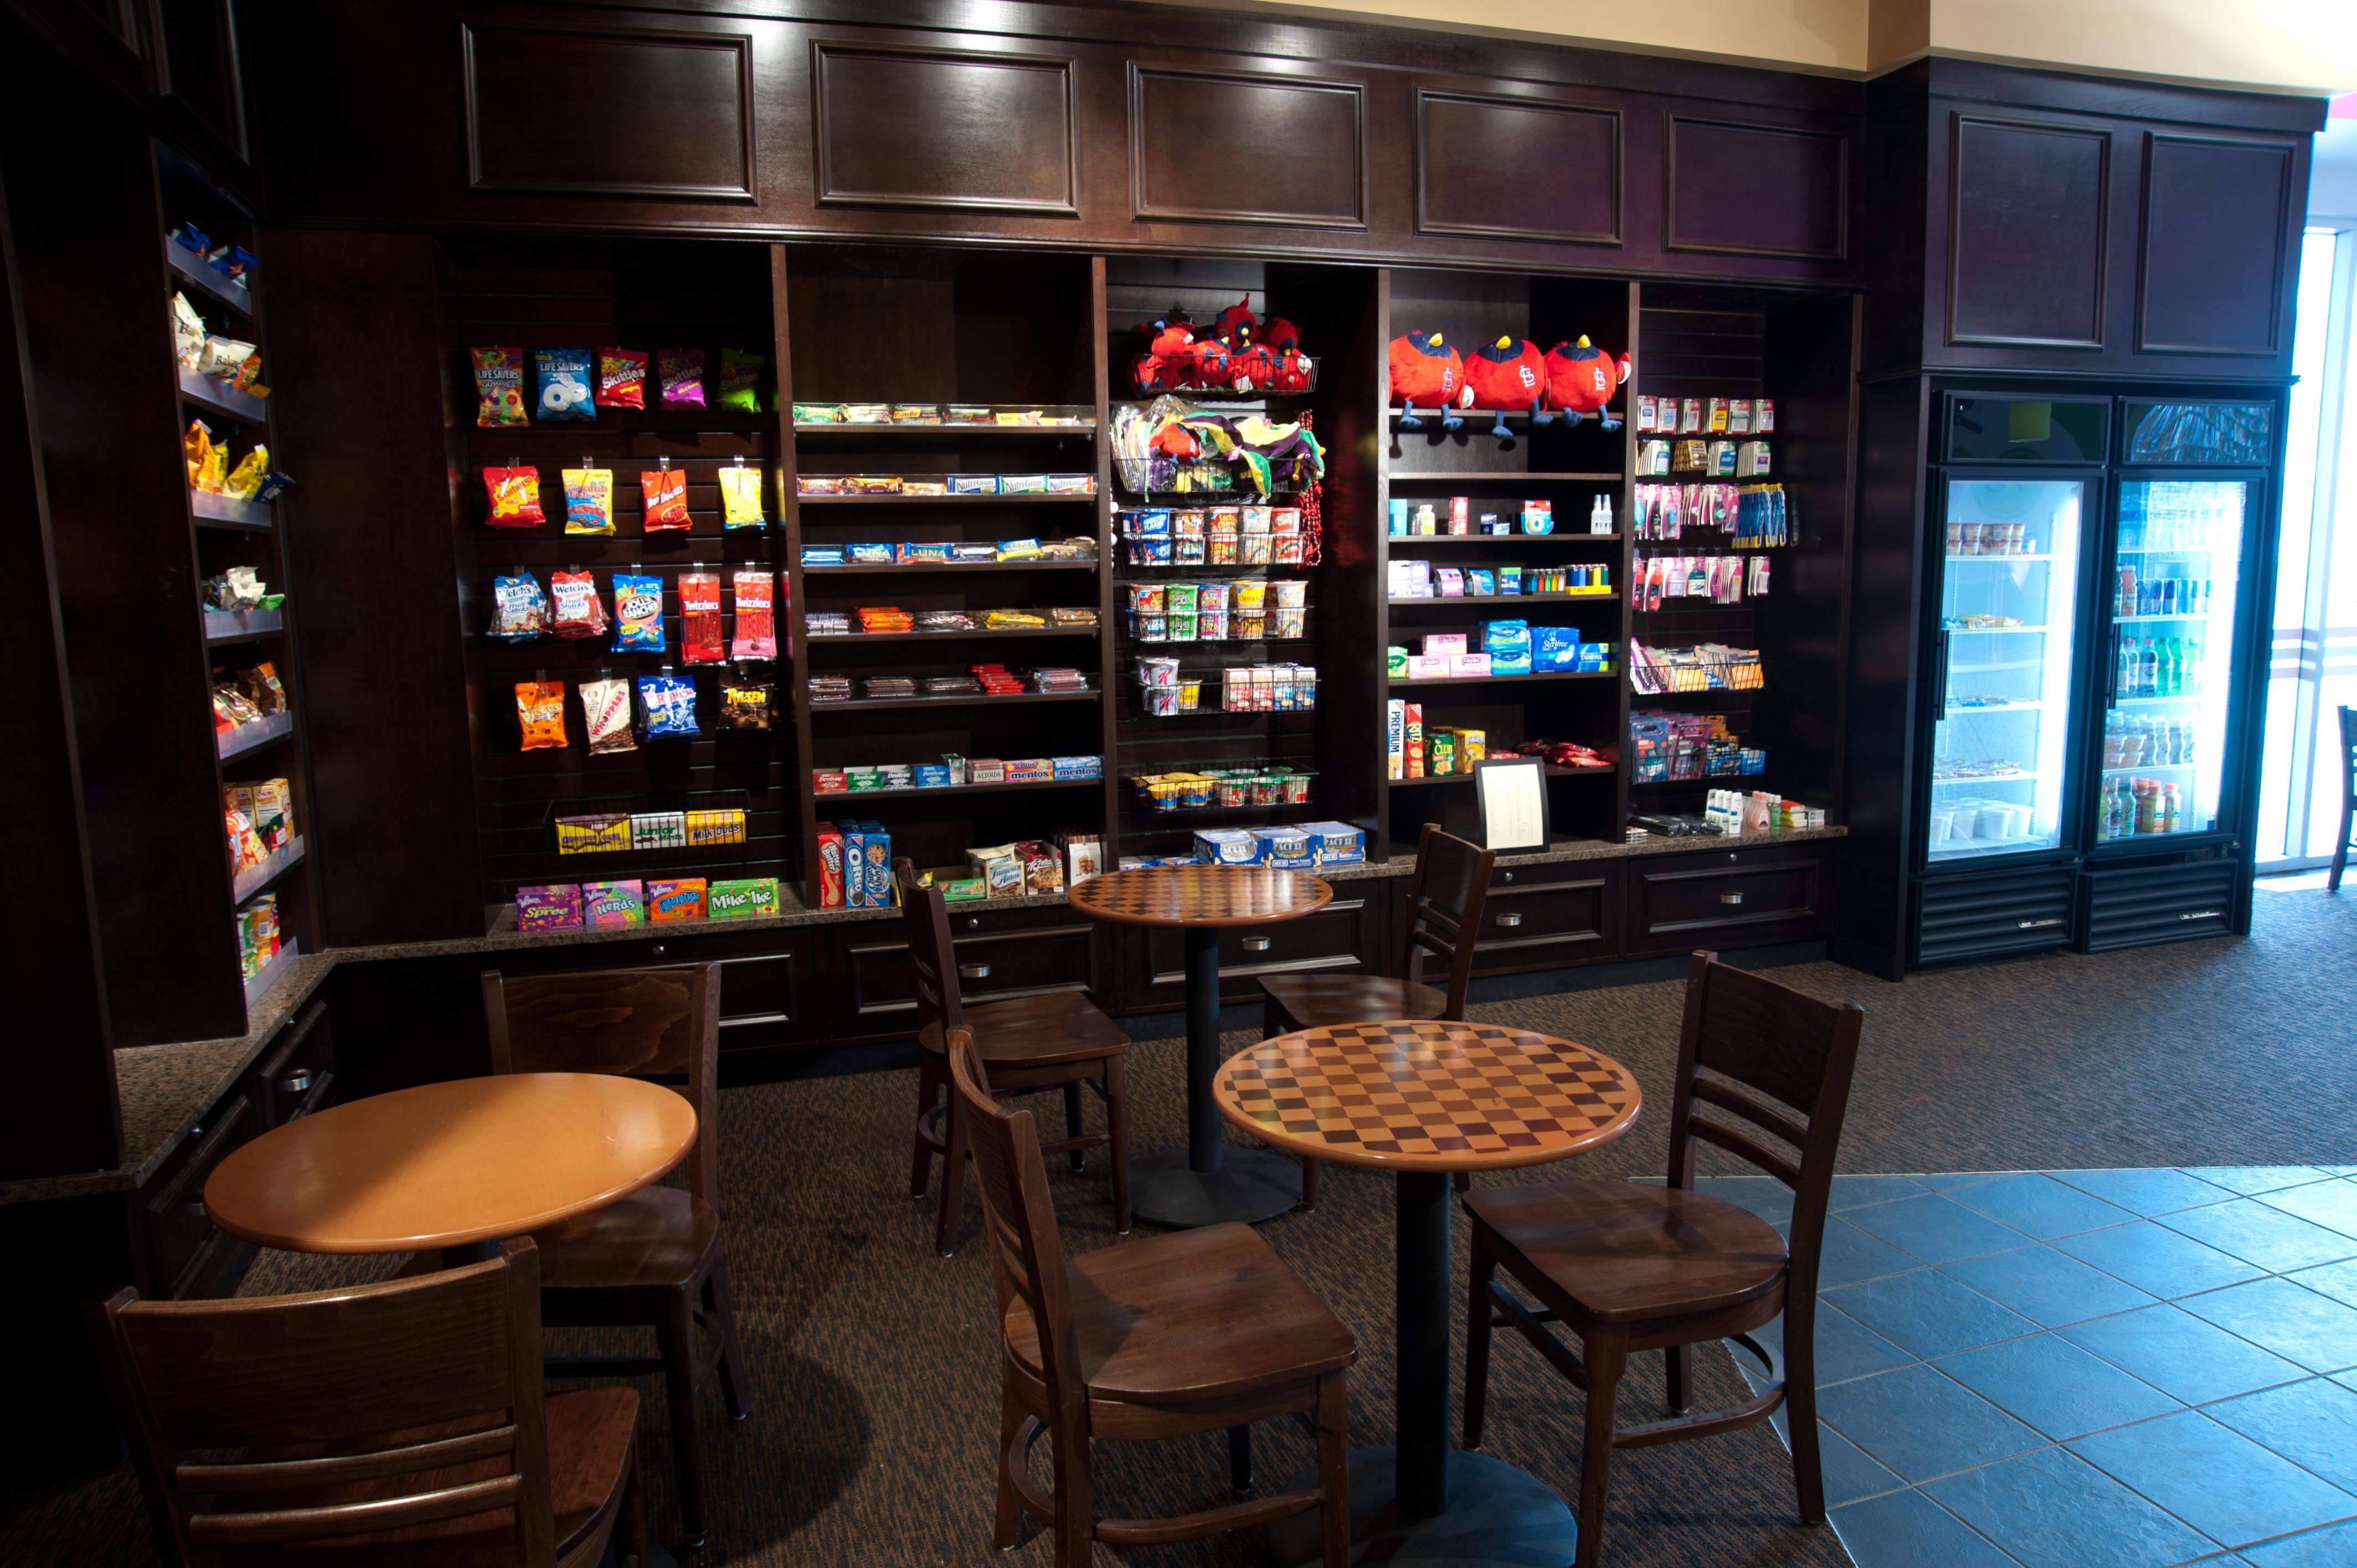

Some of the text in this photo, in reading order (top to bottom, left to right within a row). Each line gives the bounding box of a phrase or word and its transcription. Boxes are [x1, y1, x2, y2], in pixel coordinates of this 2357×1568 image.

[478, 369, 519, 379] LIFE SAVERS
[541, 362, 585, 372] LIFE SAVERS
[602, 368, 646, 389] Skittles
[661, 365, 703, 390] Skittles
[568, 484, 608, 492] Swedish
[1005, 479, 1042, 493] Nutri-Grain
[568, 491, 589, 499] Fish
[911, 549, 947, 557] LUNA
[555, 583, 589, 594] Welch's
[626, 597, 652, 610] JOLLY
[684, 601, 719, 611] Twizzlers
[735, 597, 771, 608] Twizzlers
[622, 603, 659, 619] RANCHER
[1543, 639, 1568, 651] Stayfree
[1158, 667, 1173, 685] K
[643, 688, 693, 705] RUNCH
[521, 703, 563, 724] Pieces
[591, 690, 626, 736] WHOPPERS
[1390, 711, 1401, 753] PREMIUM
[1434, 744, 1453, 755] CLUB
[976, 771, 1001, 780] ALTOIDS
[1011, 770, 1049, 780] mentos
[1059, 767, 1098, 776] mentos
[635, 827, 676, 837] Junior
[693, 823, 740, 842] Milk Duds
[821, 848, 836, 873] Butter
[847, 848, 863, 891] OREO
[865, 863, 877, 890] Chips
[989, 865, 1020, 880] Famous
[997, 871, 1020, 886] Amos
[658, 891, 700, 913] RUNTS
[711, 890, 773, 911] Mike Ike
[524, 906, 569, 919] Spree
